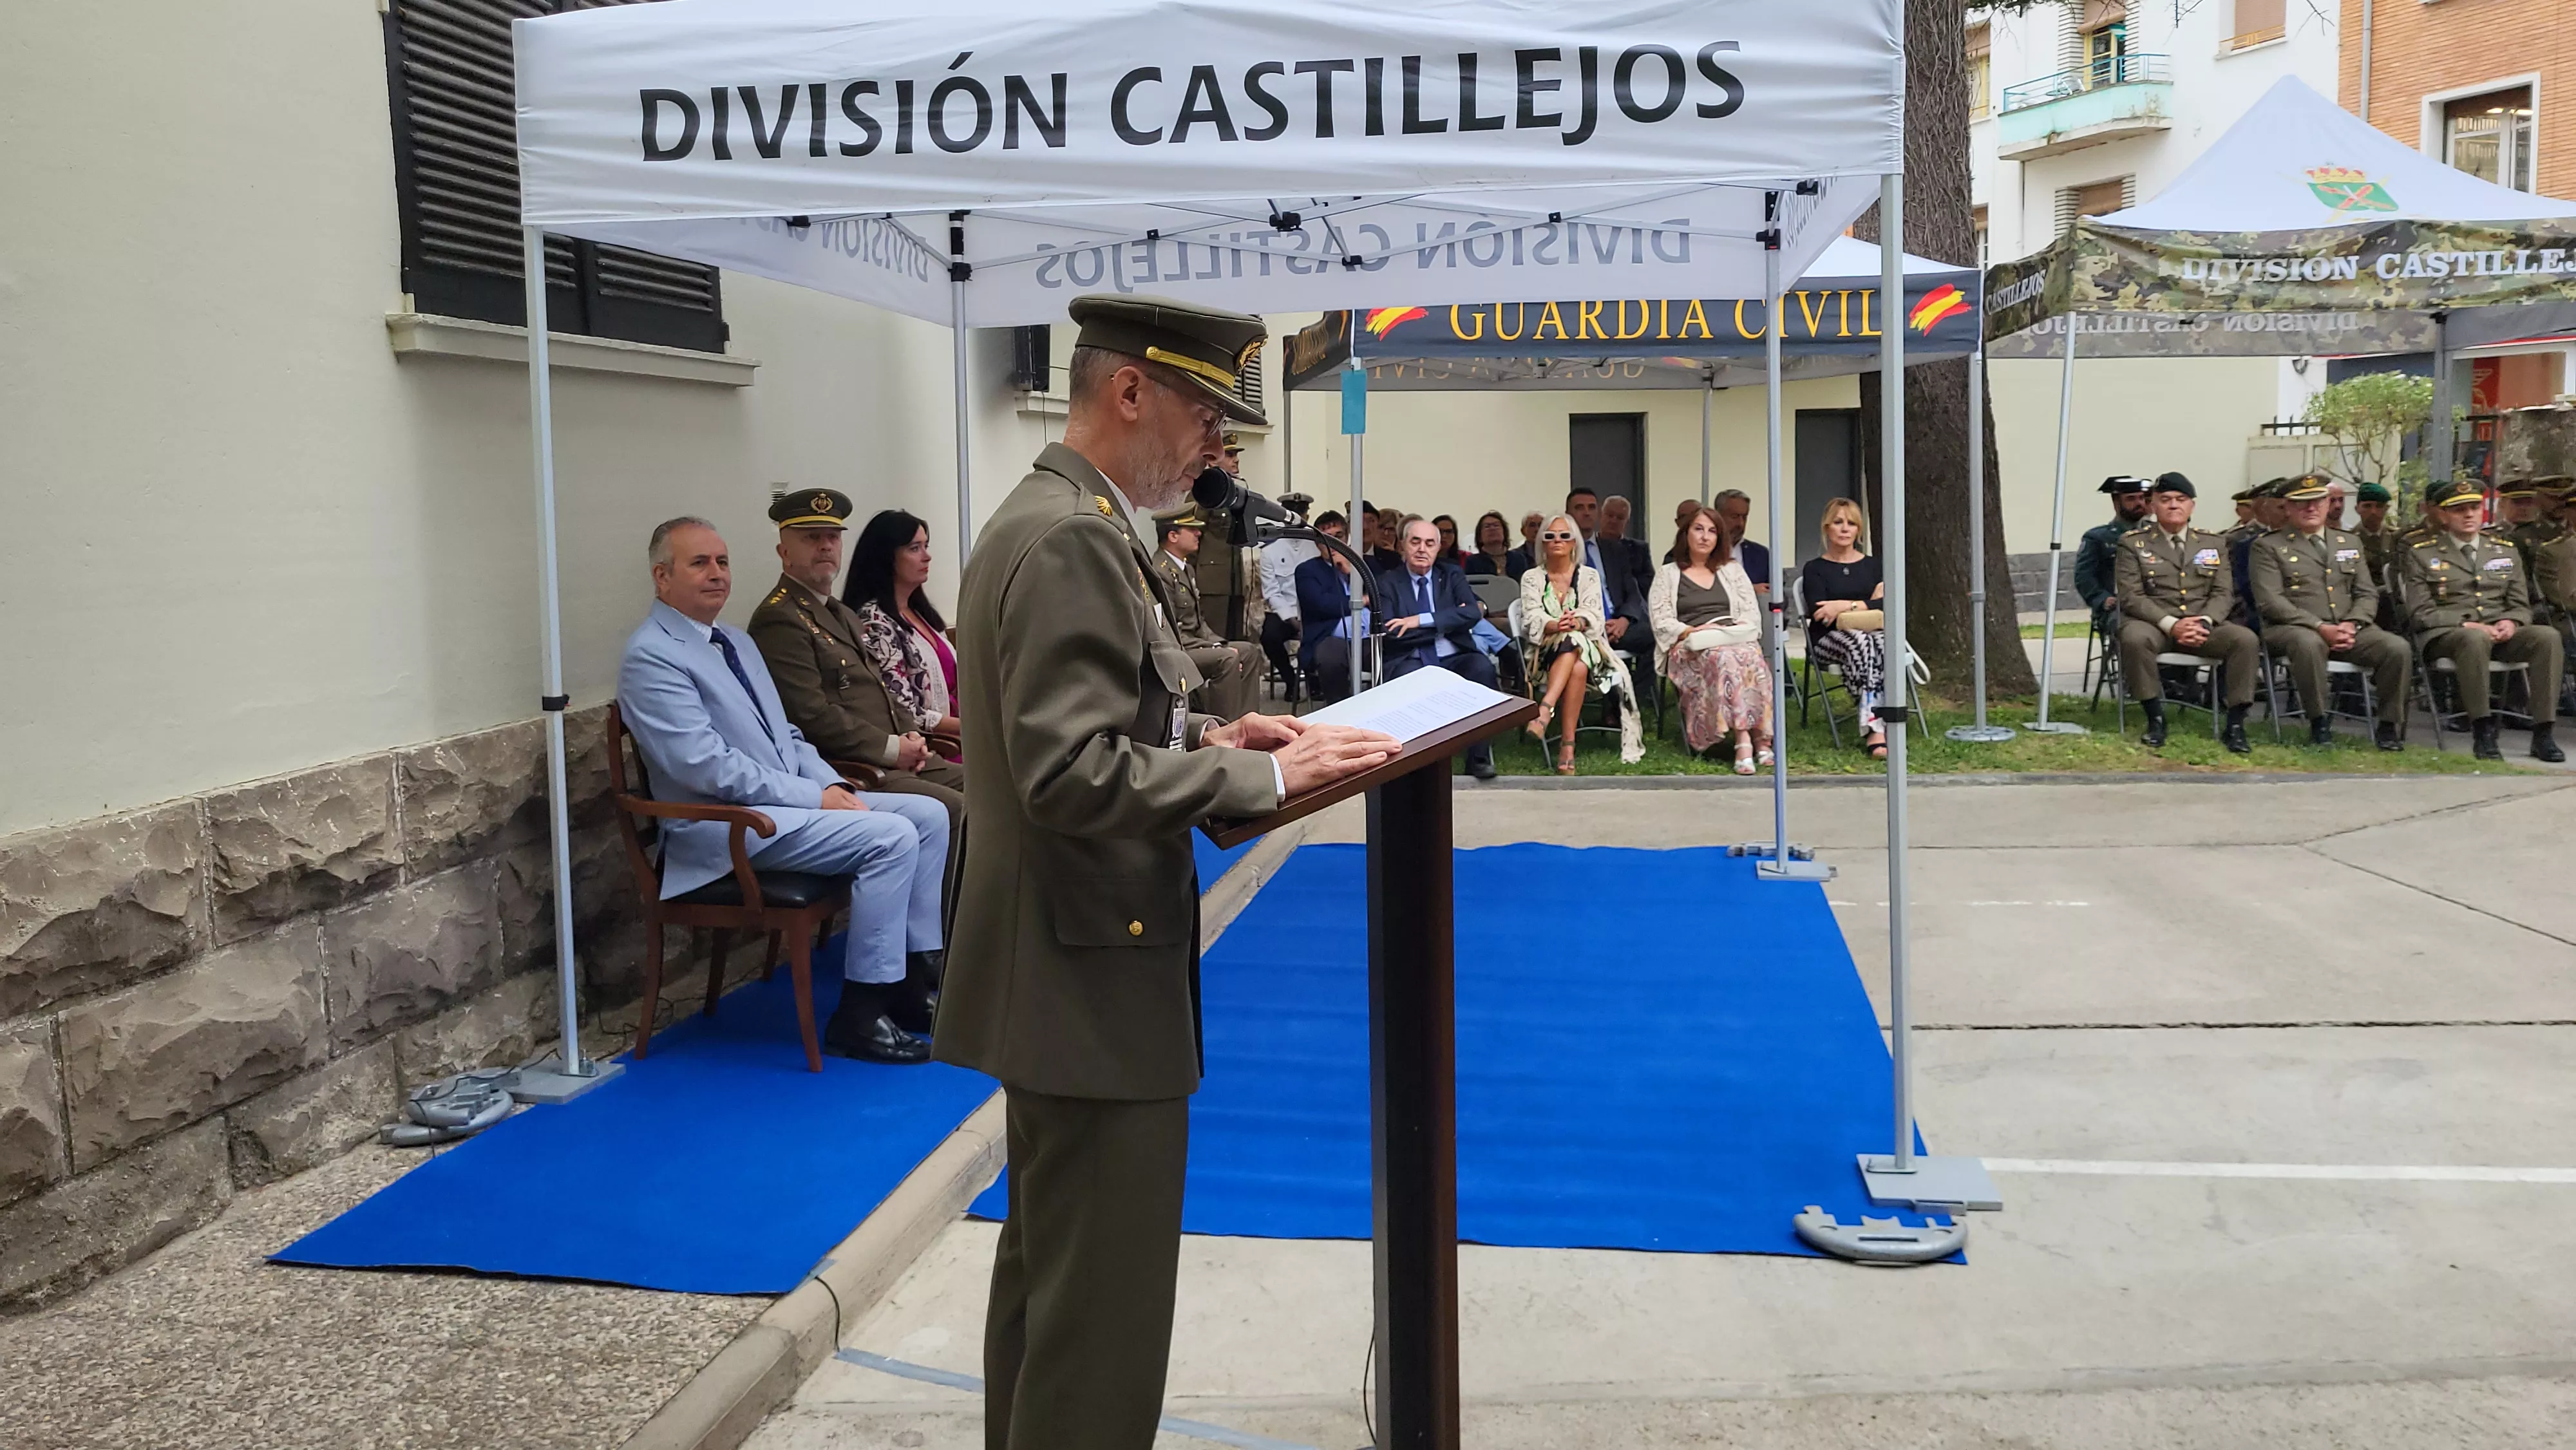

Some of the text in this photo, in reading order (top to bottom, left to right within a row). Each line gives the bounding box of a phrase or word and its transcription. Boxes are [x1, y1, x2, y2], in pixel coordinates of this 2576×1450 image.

[639, 40, 1745, 162] DIVISIÓN CASTILLEJOS
[2182, 249, 2360, 281] DIVISIÓN
[1449, 288, 1882, 341] GUARDIA CIVIL
[1985, 268, 2047, 315] CASTILLEJOS
